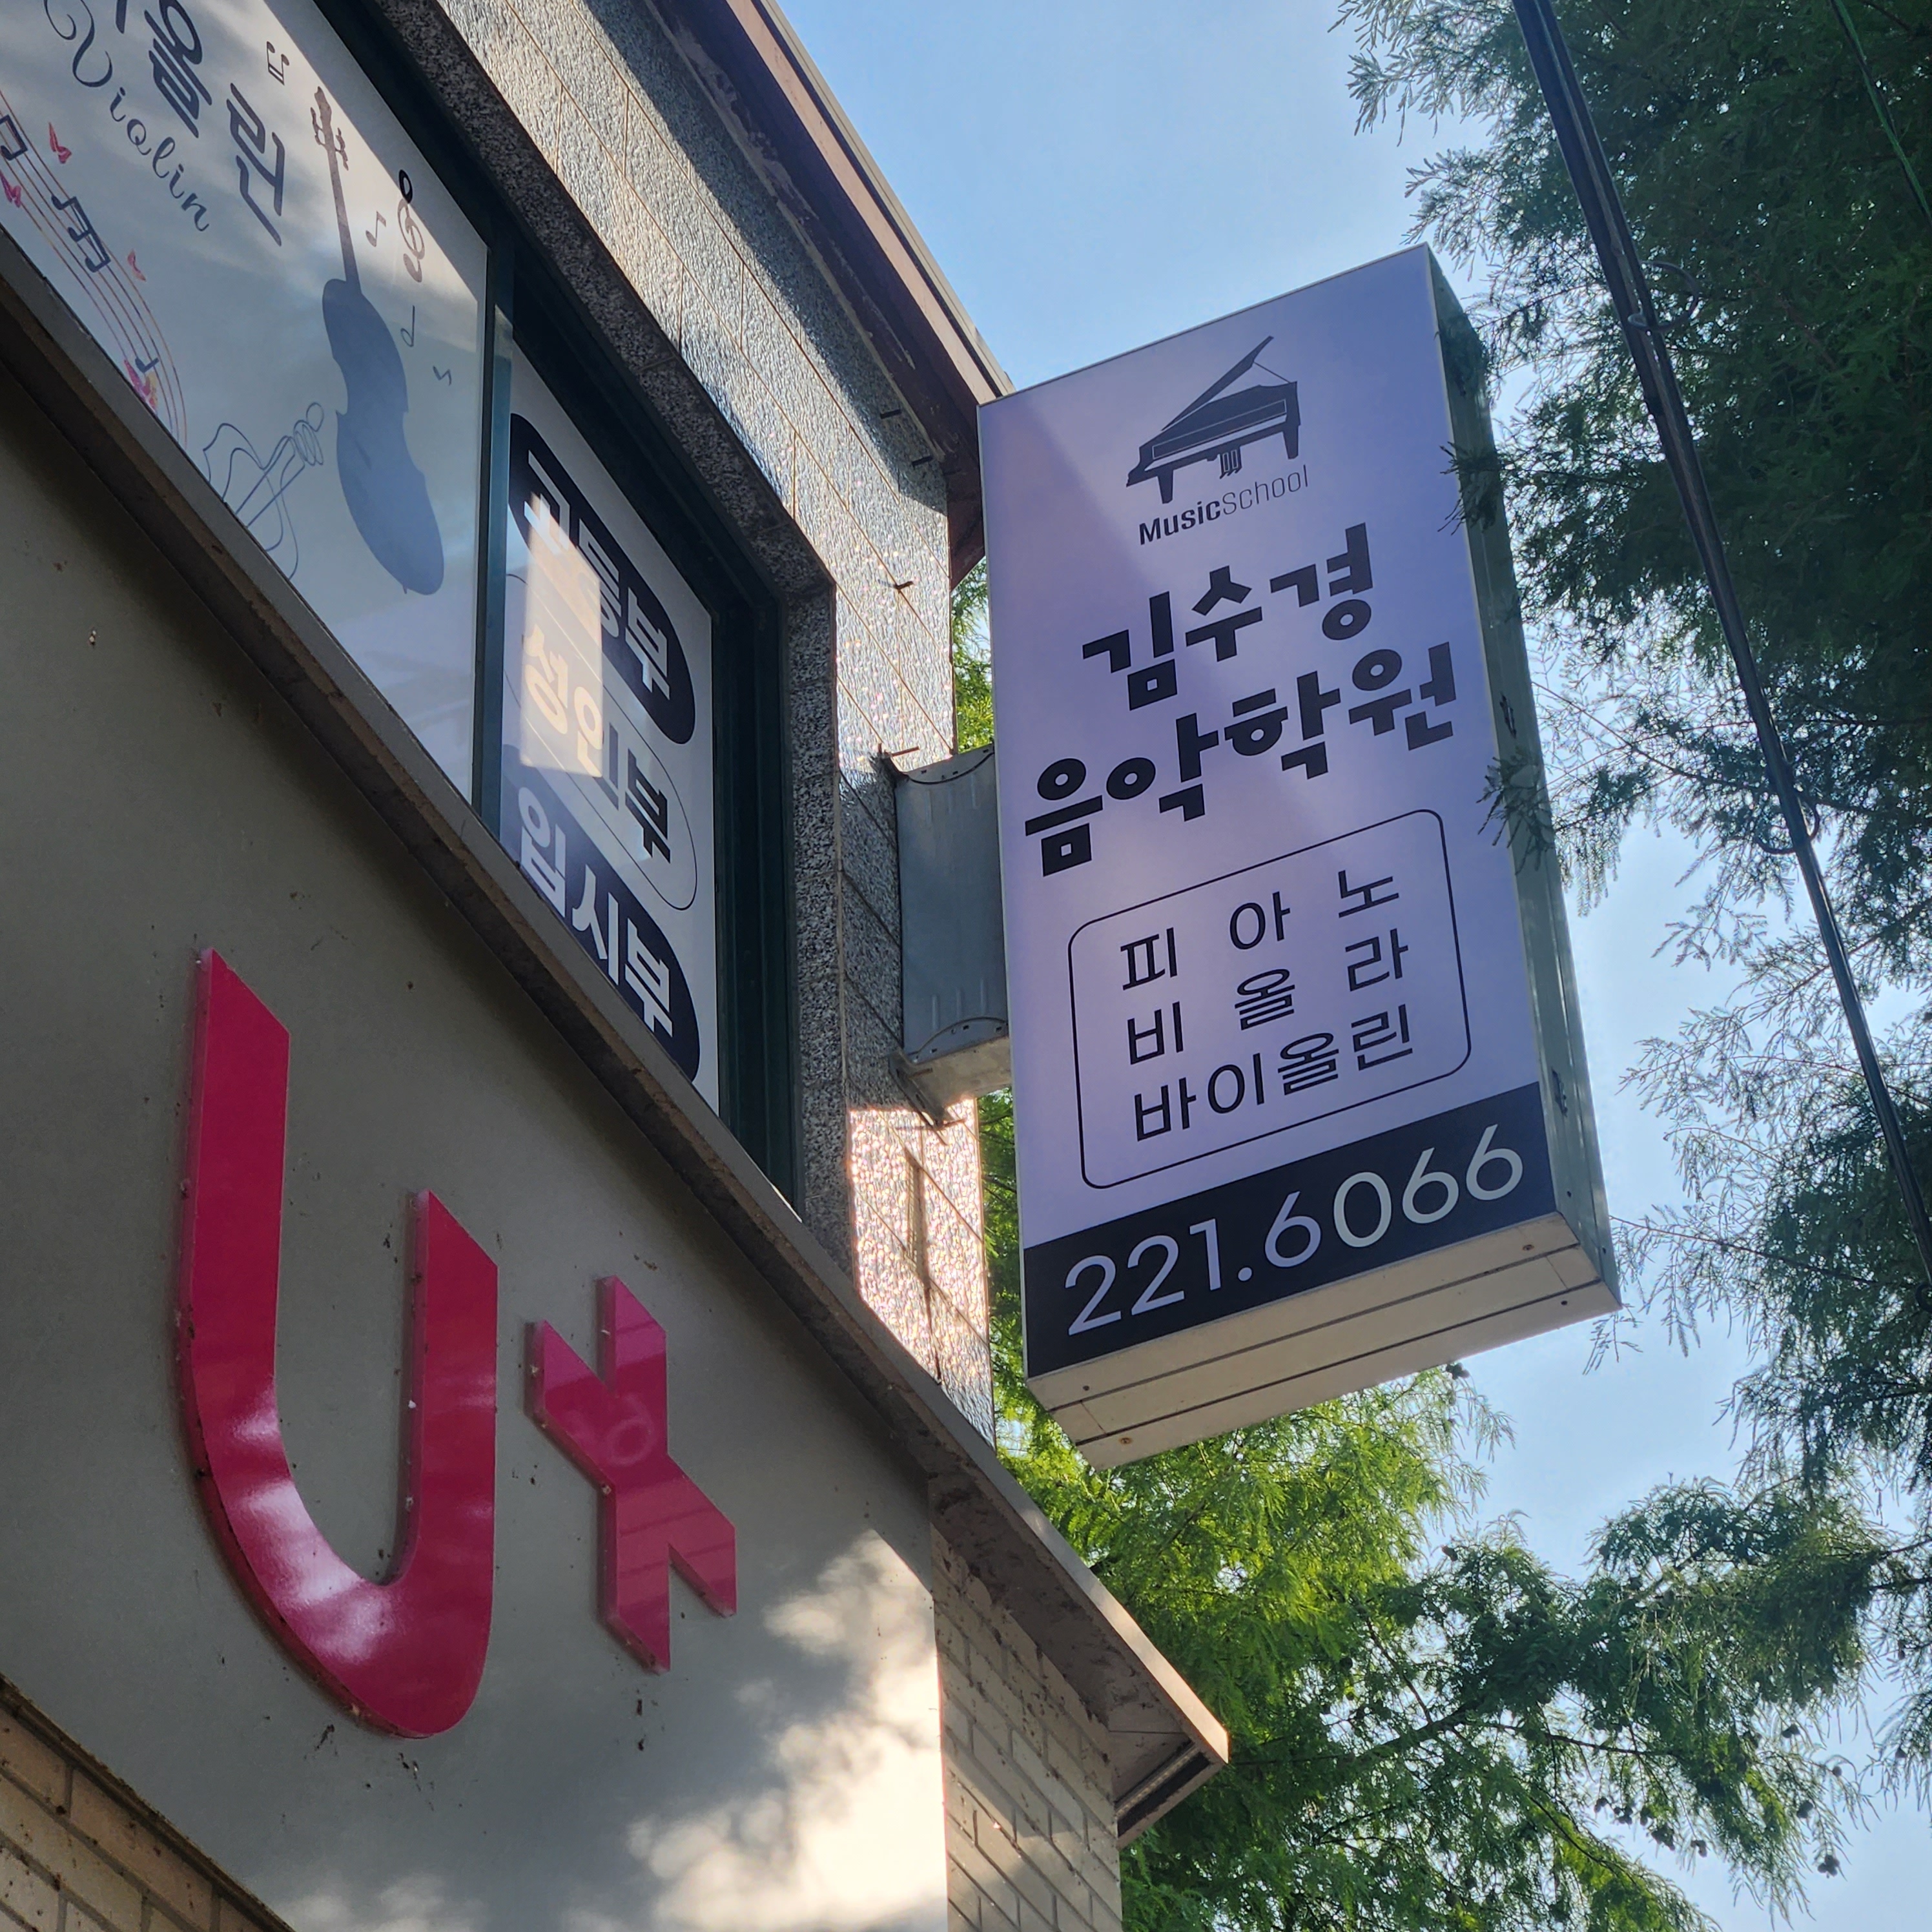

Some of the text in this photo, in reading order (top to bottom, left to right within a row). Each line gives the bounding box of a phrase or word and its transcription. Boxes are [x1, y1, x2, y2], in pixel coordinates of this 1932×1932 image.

[43, 0, 209, 232] Violin
[116, 0, 282, 246] 올린
[524, 450, 670, 701] 고등부
[1082, 522, 1373, 711] 김수경
[522, 623, 671, 864] 성인부
[1025, 642, 1457, 876] 음악학원
[519, 786, 673, 1038] 입시부
[1135, 1004, 1413, 1141] 바이올린
[1064, 1124, 1524, 1336] 221.6066
